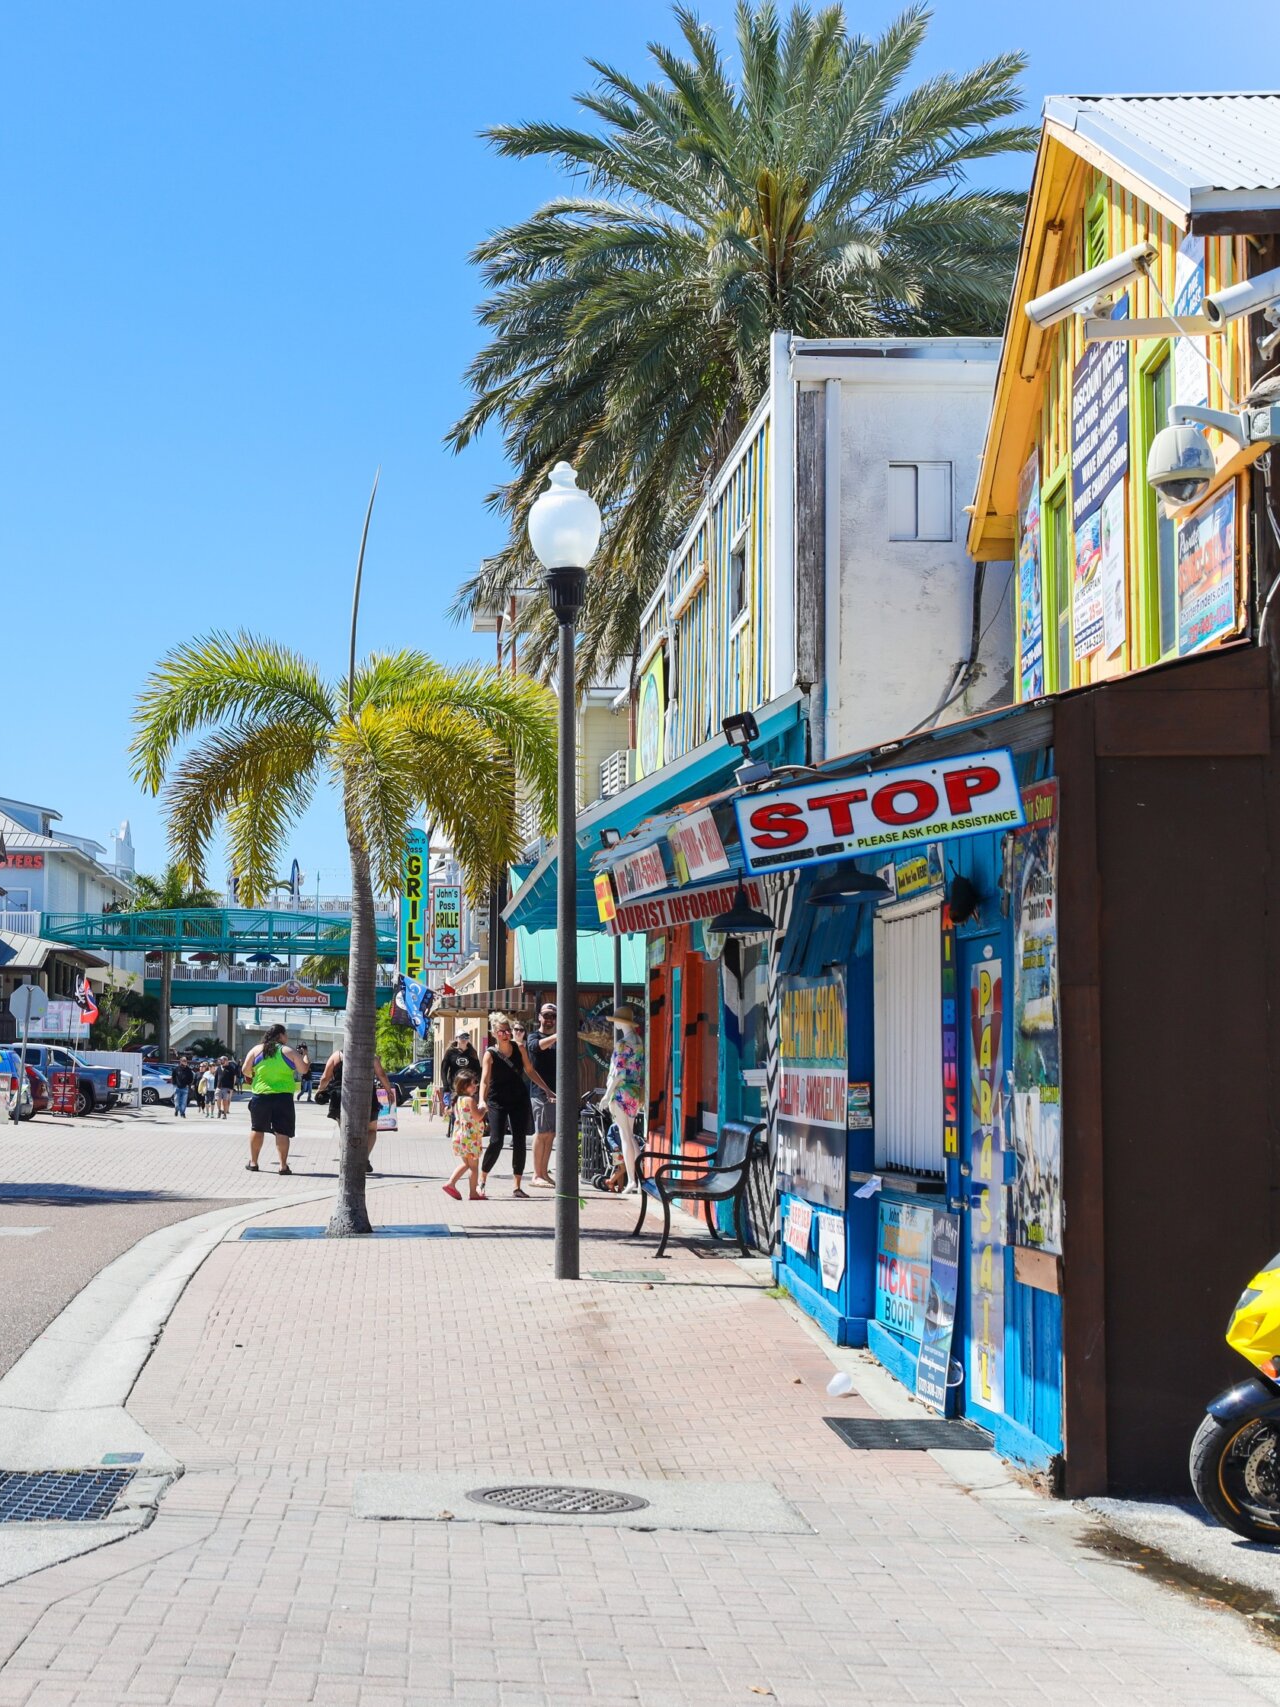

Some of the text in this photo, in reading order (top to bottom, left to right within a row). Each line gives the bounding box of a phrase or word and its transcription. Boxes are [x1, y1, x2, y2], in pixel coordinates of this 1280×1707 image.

[1073, 361, 1101, 420] DISCOUNT
[750, 766, 1001, 849] STOP
[857, 809, 1017, 847] PLEASE ASK FOR ASSISTANCE
[1035, 795, 1053, 820] Show
[406, 844, 423, 853] Pass
[407, 856, 421, 979] GRILLE
[436, 888, 458, 899] John's
[439, 900, 455, 910] Pass
[611, 900, 667, 935] TOURIST
[668, 881, 762, 924] INFORMATN
[435, 912, 459, 929] GRILLE
[781, 984, 844, 1058] OLPHIN SHOW
[942, 903, 957, 1153] AIRBRUSH
[593, 1053, 610, 1069] MADE
[806, 1075, 845, 1124] SNORKELING
[979, 970, 994, 1400] PARASAIL
[878, 1253, 930, 1305] TICKET
[885, 1296, 915, 1333] BOOTH
